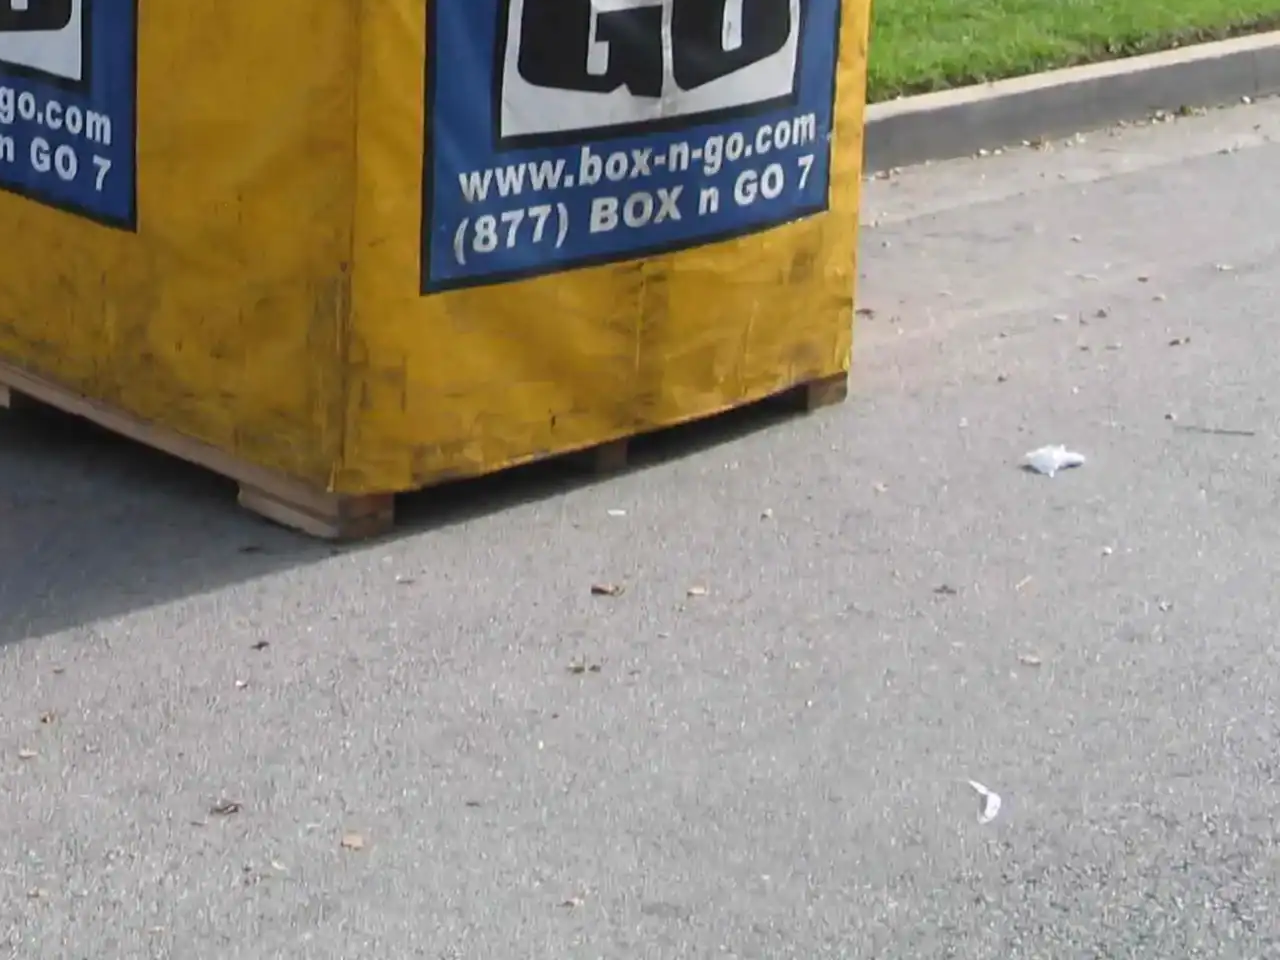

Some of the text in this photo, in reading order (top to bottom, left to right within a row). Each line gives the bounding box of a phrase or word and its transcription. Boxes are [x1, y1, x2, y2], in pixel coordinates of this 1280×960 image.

[30, 137, 78, 181] GO
[92, 156, 112, 192] 7
[458, 111, 816, 202] www.box-n-go.com
[453, 154, 815, 266] (877) BOX n GO 7
